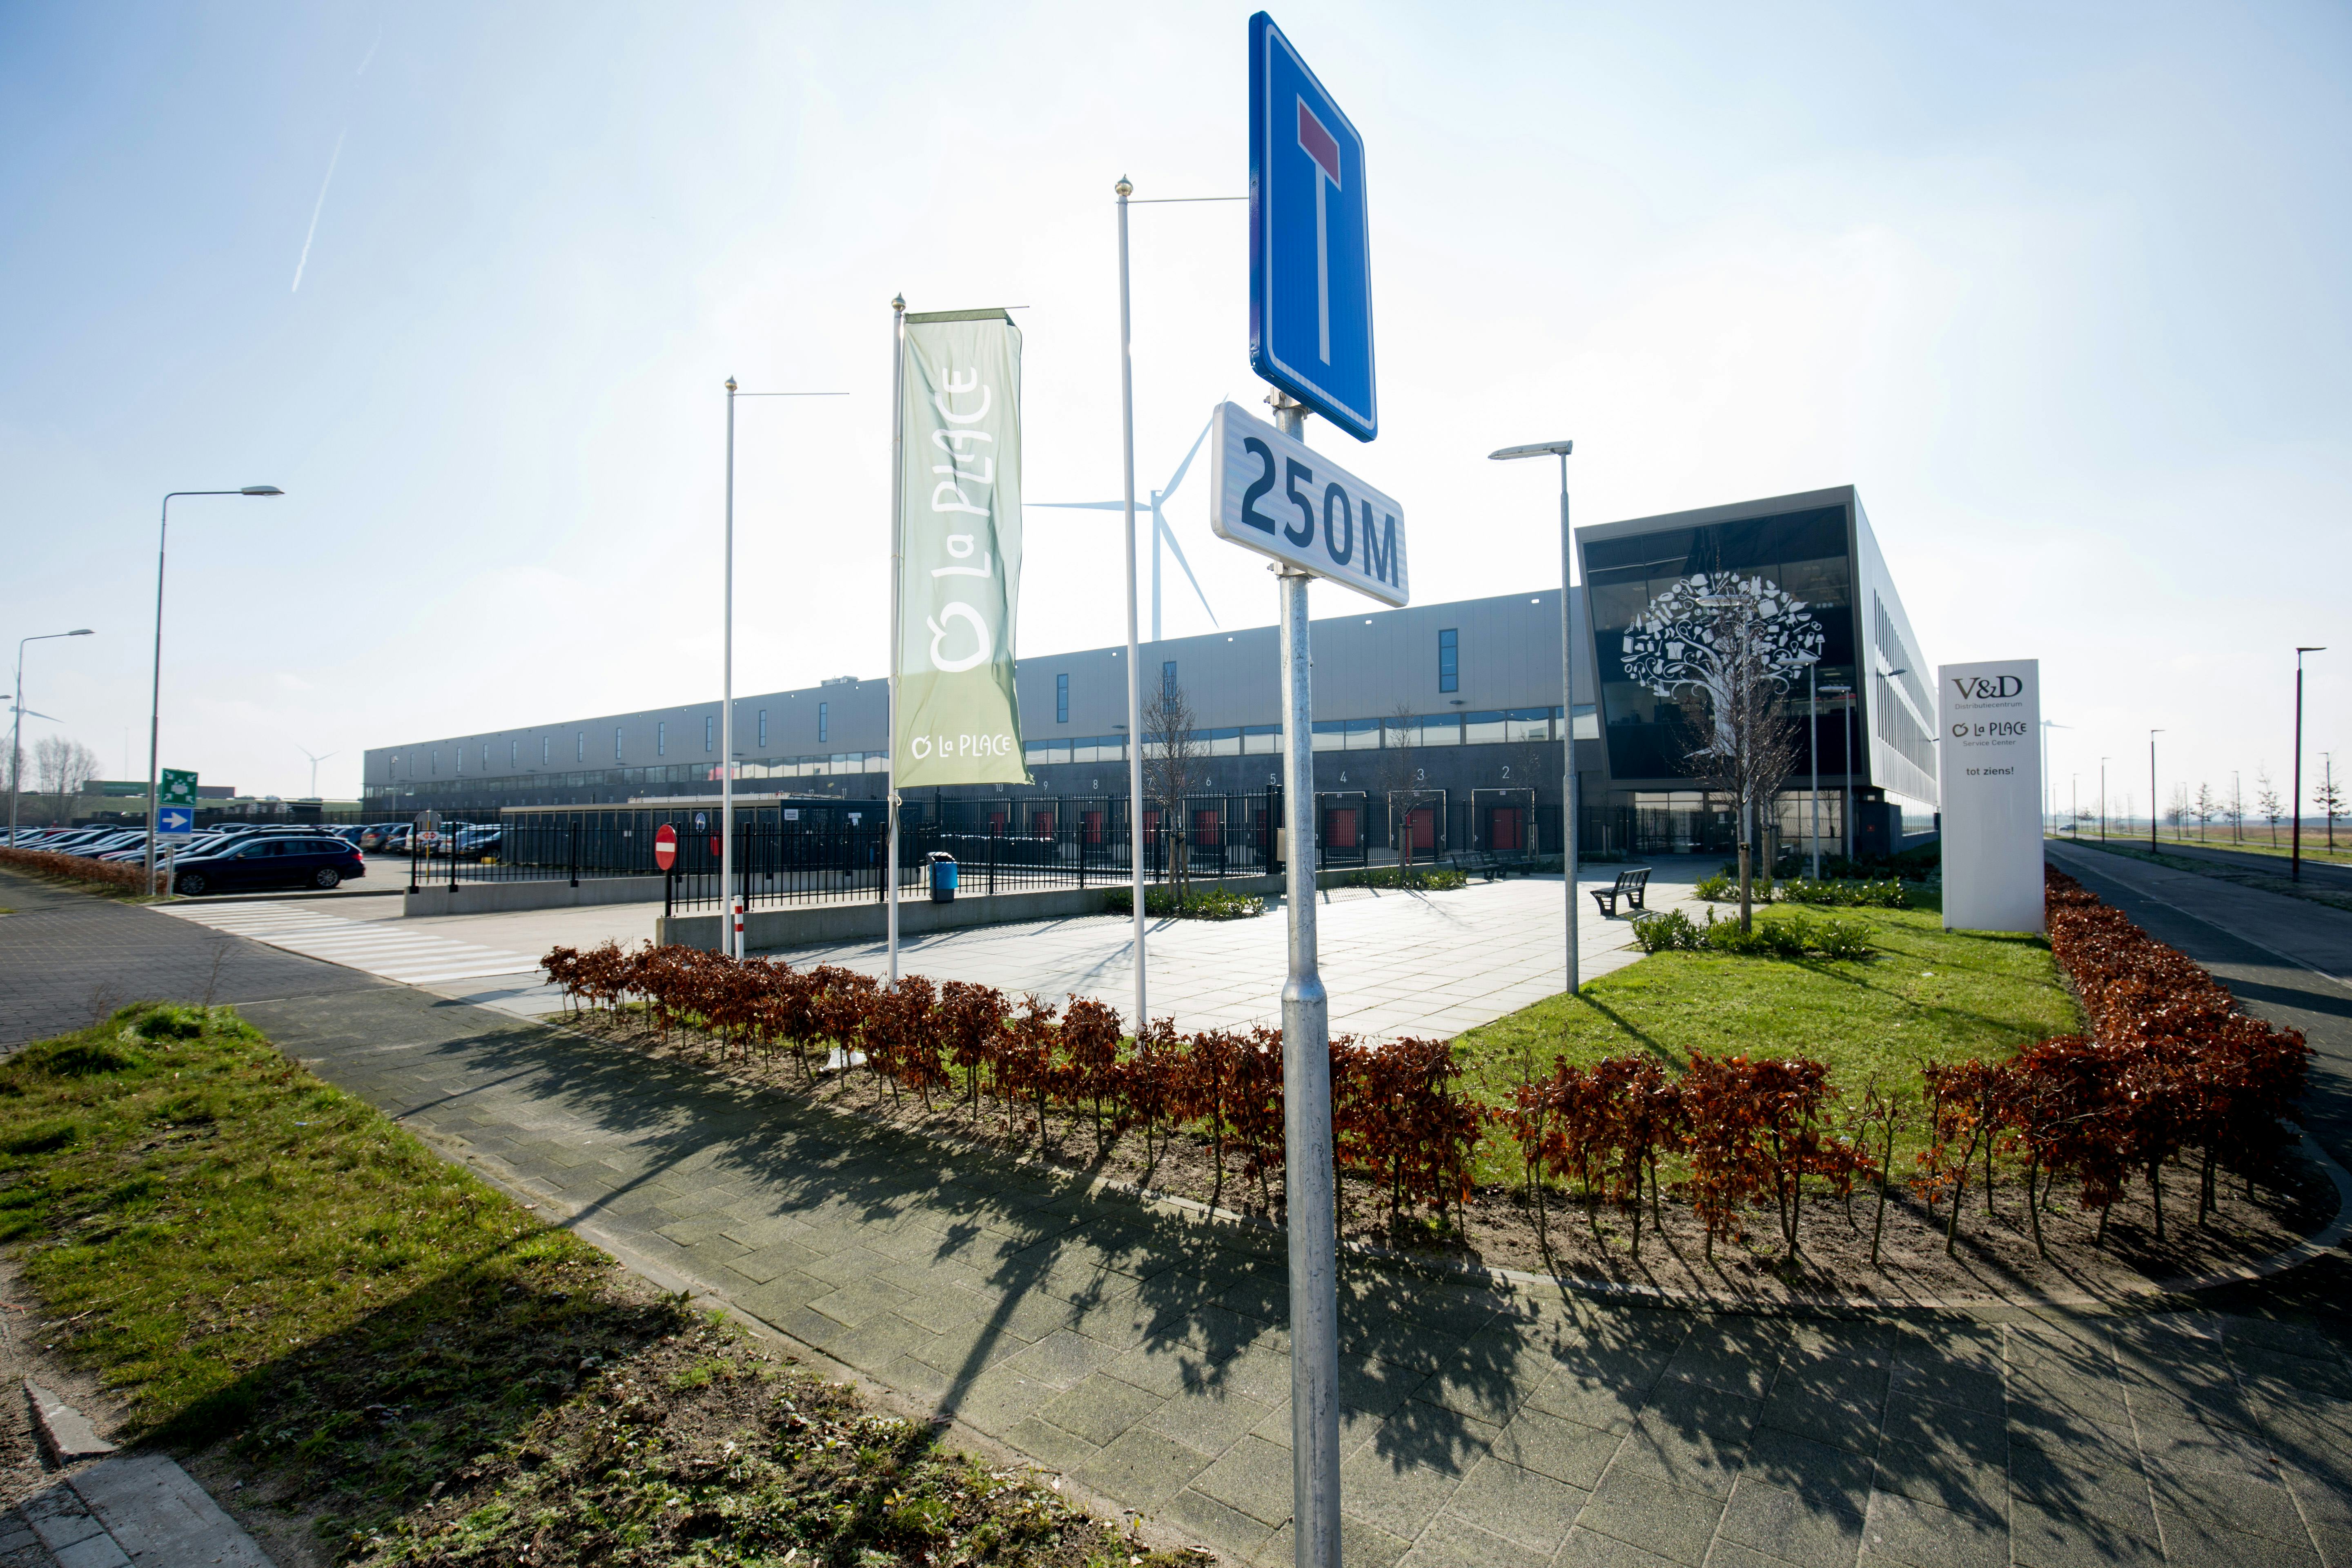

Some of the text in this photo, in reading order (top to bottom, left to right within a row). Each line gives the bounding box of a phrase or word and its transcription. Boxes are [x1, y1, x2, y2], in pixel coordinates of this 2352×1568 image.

[931, 367, 993, 578] La PLACE
[1241, 437, 1399, 589] 250M
[1951, 675, 2023, 699] V&D
[1955, 702, 2022, 710] Distributiecentrum
[1974, 722, 2027, 737] La PLACE
[939, 734, 1011, 757] La PLACE
[1417, 768, 1424, 780] 3
[1502, 766, 1510, 778] 2
[1983, 766, 2014, 775] ziens!
[1147, 777, 1153, 787] 7
[1206, 777, 1212, 786] 6
[1270, 773, 1276, 784] 5
[1340, 771, 1347, 783] 4
[996, 783, 1003, 792] 10
[1044, 781, 1048, 791] 9
[1093, 780, 1098, 789] 8
[842, 788, 847, 796] 11
